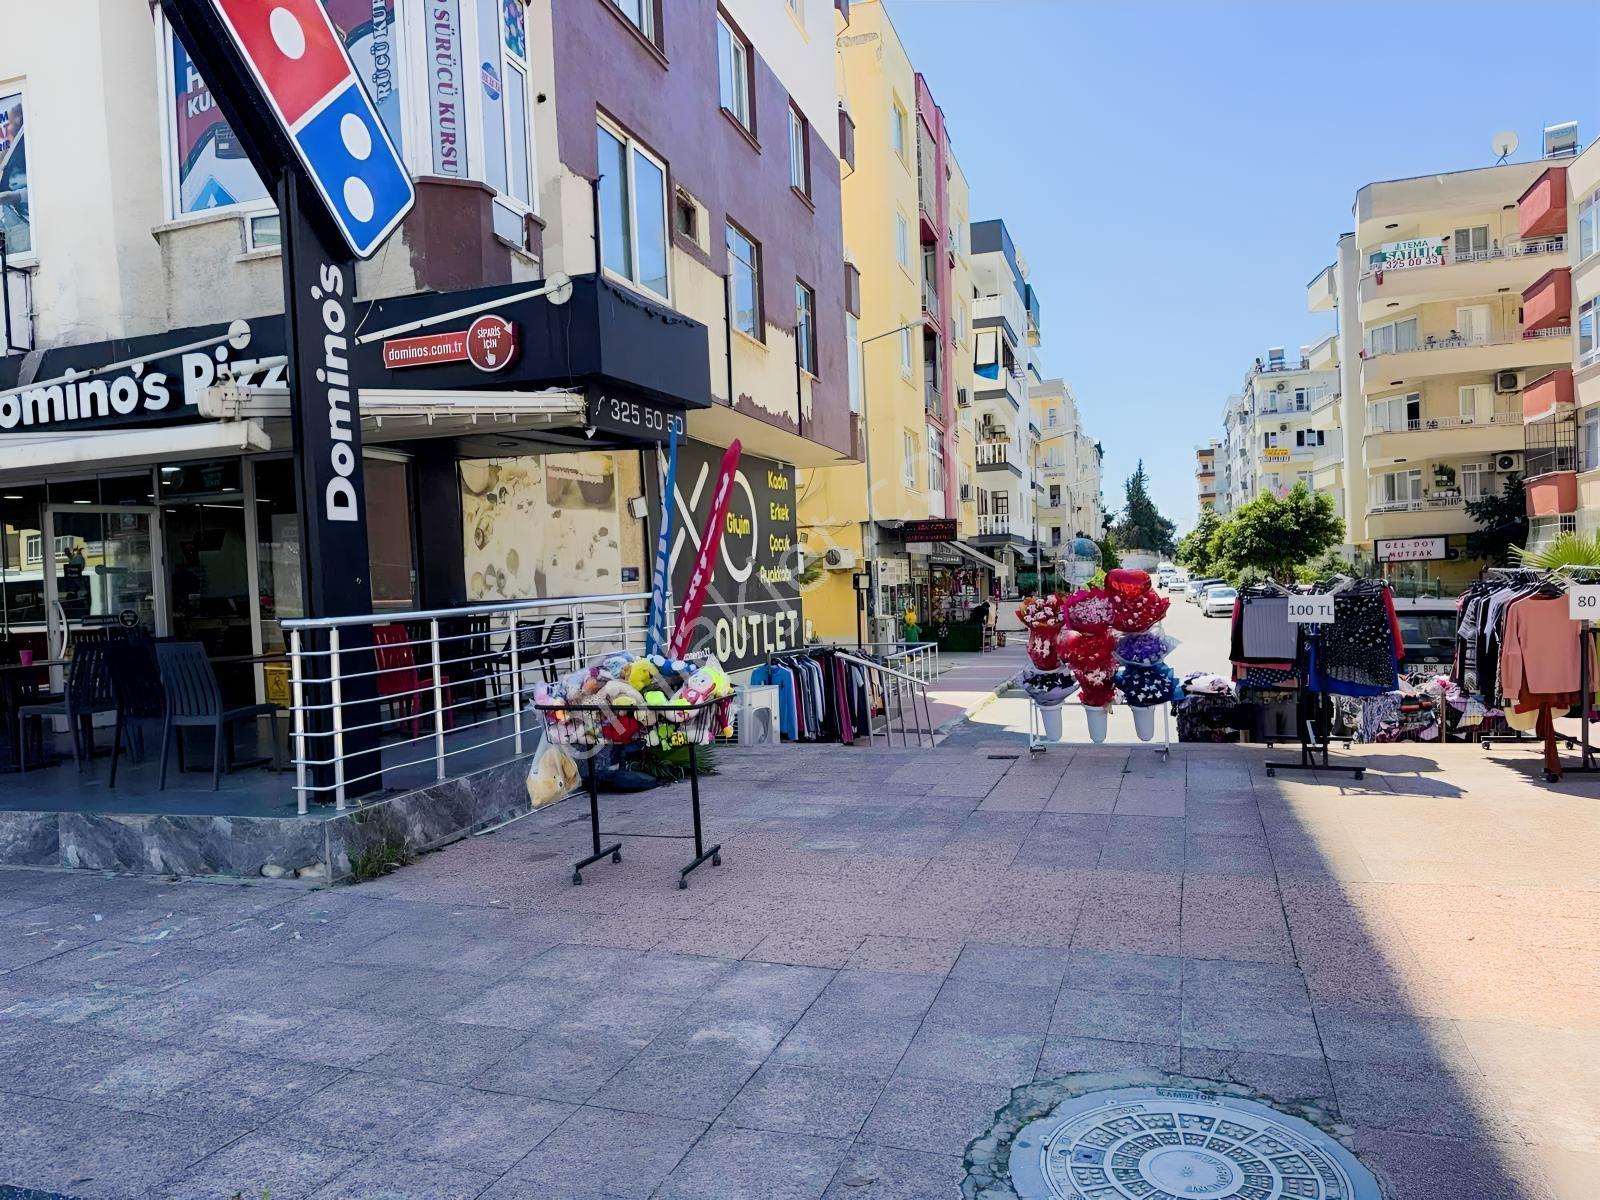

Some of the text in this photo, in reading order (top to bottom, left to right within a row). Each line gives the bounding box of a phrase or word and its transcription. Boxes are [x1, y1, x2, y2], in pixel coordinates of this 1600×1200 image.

[371, 41, 392, 103] RÜCÜ
[434, 8, 458, 174] SÜRÜCÜ KURSU
[1386, 259, 1405, 269] 325
[1408, 258, 1421, 267] 00
[1425, 256, 1438, 264] 33
[388, 341, 463, 361] dominos.com.tr
[181, 345, 290, 406] Pizz
[311, 263, 358, 522] Domino's
[610, 398, 684, 435] 325 50 50
[767, 470, 788, 491] Kadın
[769, 502, 790, 522] Erkek
[726, 512, 751, 539] Giyim
[769, 533, 791, 557] Çocuk
[1385, 540, 1436, 549] GEL-DOY
[1389, 550, 1433, 558] MUTFAK
[1289, 605, 1334, 615] 100 TL
[1577, 595, 1597, 608] 80
[715, 610, 798, 662] OUTLET
